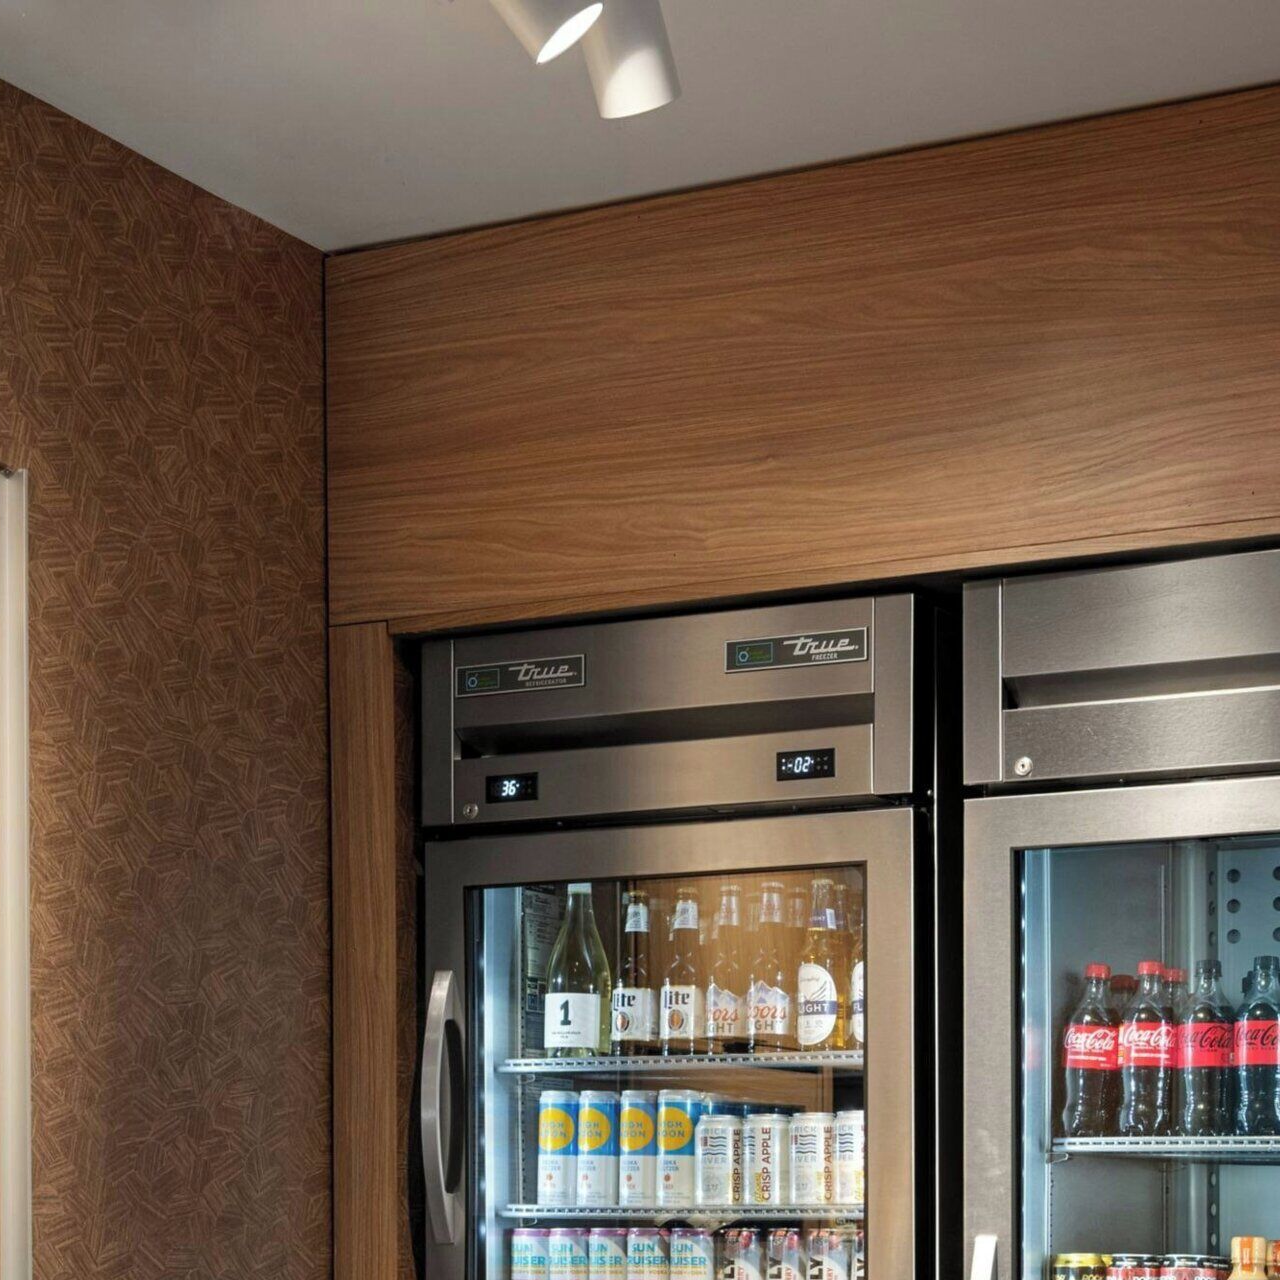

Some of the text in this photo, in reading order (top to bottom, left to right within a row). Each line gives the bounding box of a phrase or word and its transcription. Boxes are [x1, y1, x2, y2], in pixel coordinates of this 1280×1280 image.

[812, 652, 838, 661] FREEZER
[560, 999, 571, 1026] 1
[733, 1129, 741, 1164] APPLE
[762, 1127, 771, 1163] APPLE
[824, 1126, 833, 1163] APPLE
